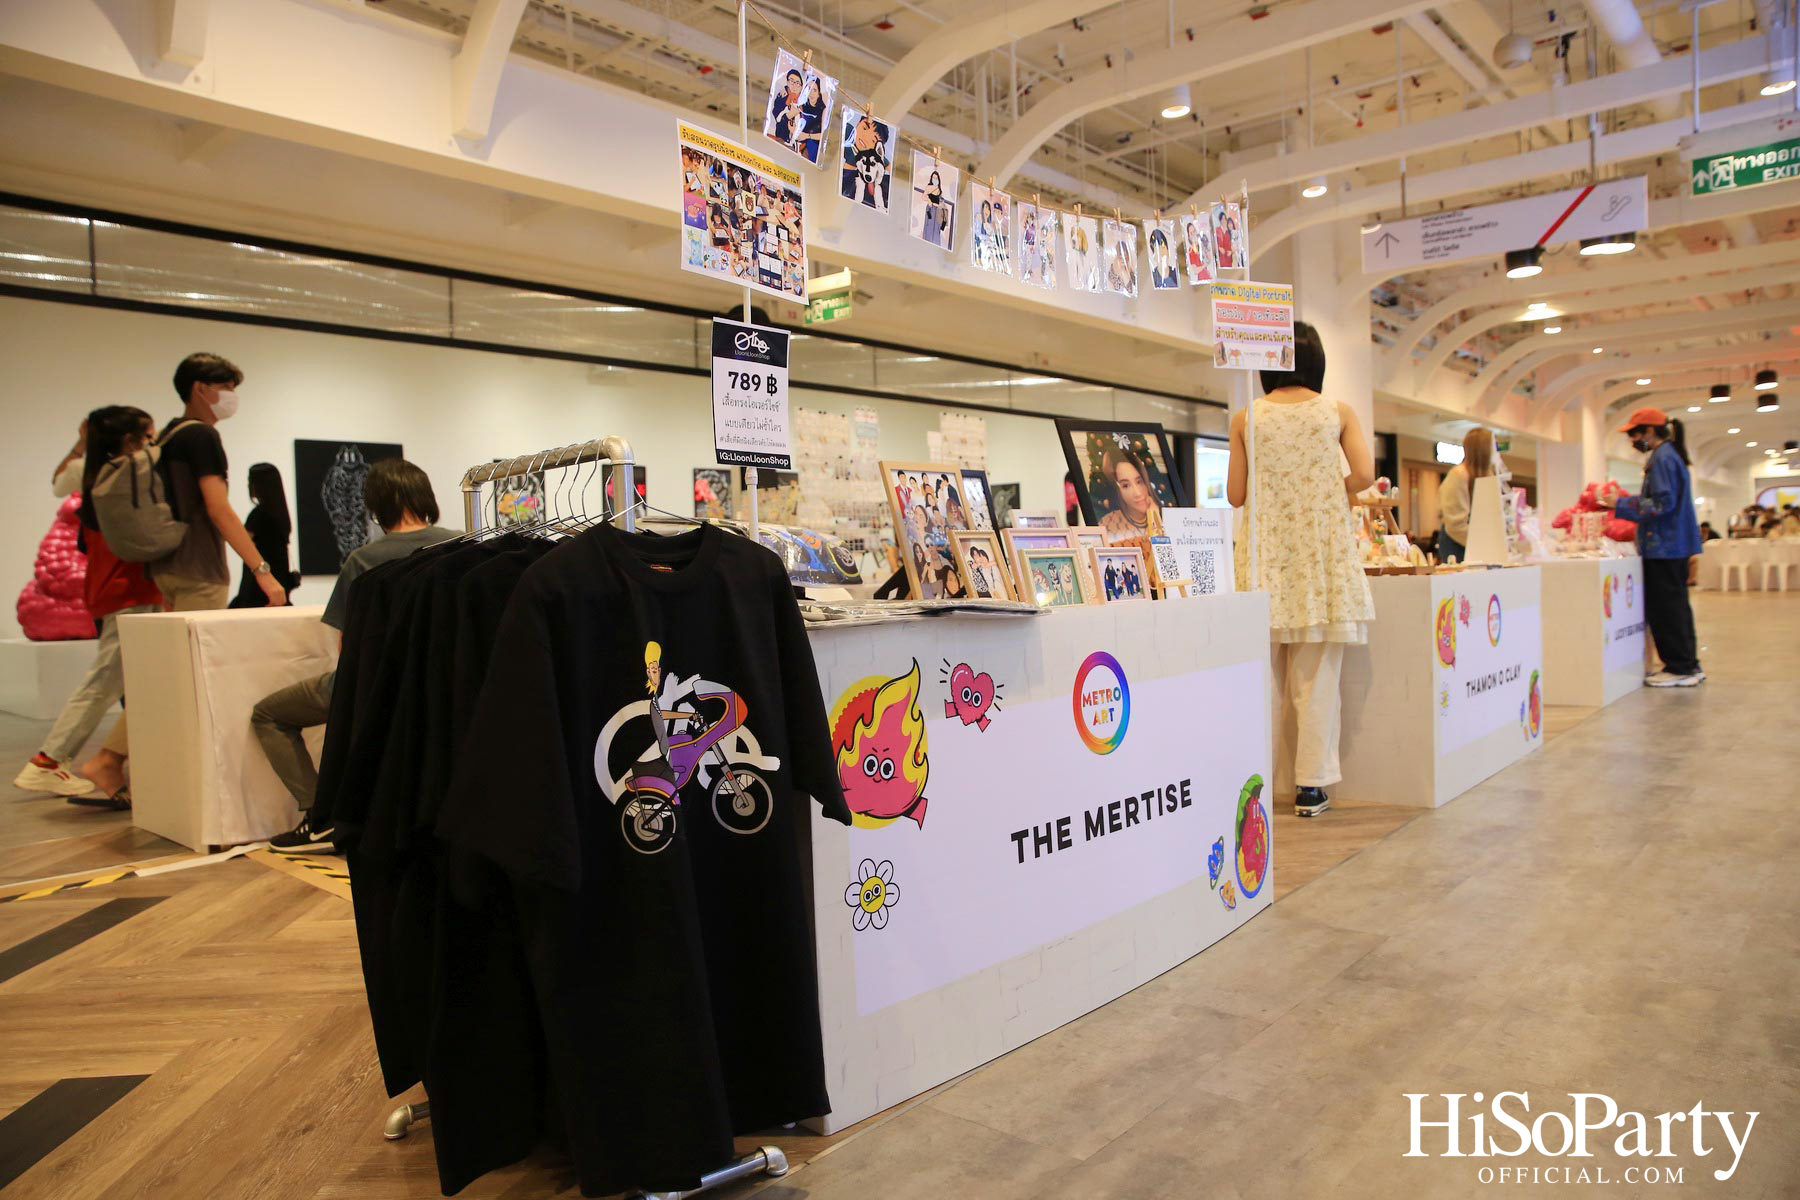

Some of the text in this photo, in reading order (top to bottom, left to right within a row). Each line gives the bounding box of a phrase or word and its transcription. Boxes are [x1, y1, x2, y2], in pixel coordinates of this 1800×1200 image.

[1733, 146, 1800, 171] ทางออก
[1763, 164, 1800, 181] EXIT
[1238, 286, 1260, 301] Digital
[1263, 289, 1293, 301] Portrait
[728, 371, 761, 392] 789
[1466, 673, 1497, 698] THAMON
[1506, 664, 1521, 683] CLAY
[1082, 687, 1121, 707] METRO
[1093, 708, 1114, 725] ART
[1011, 778, 1193, 864] THE MERTISE
